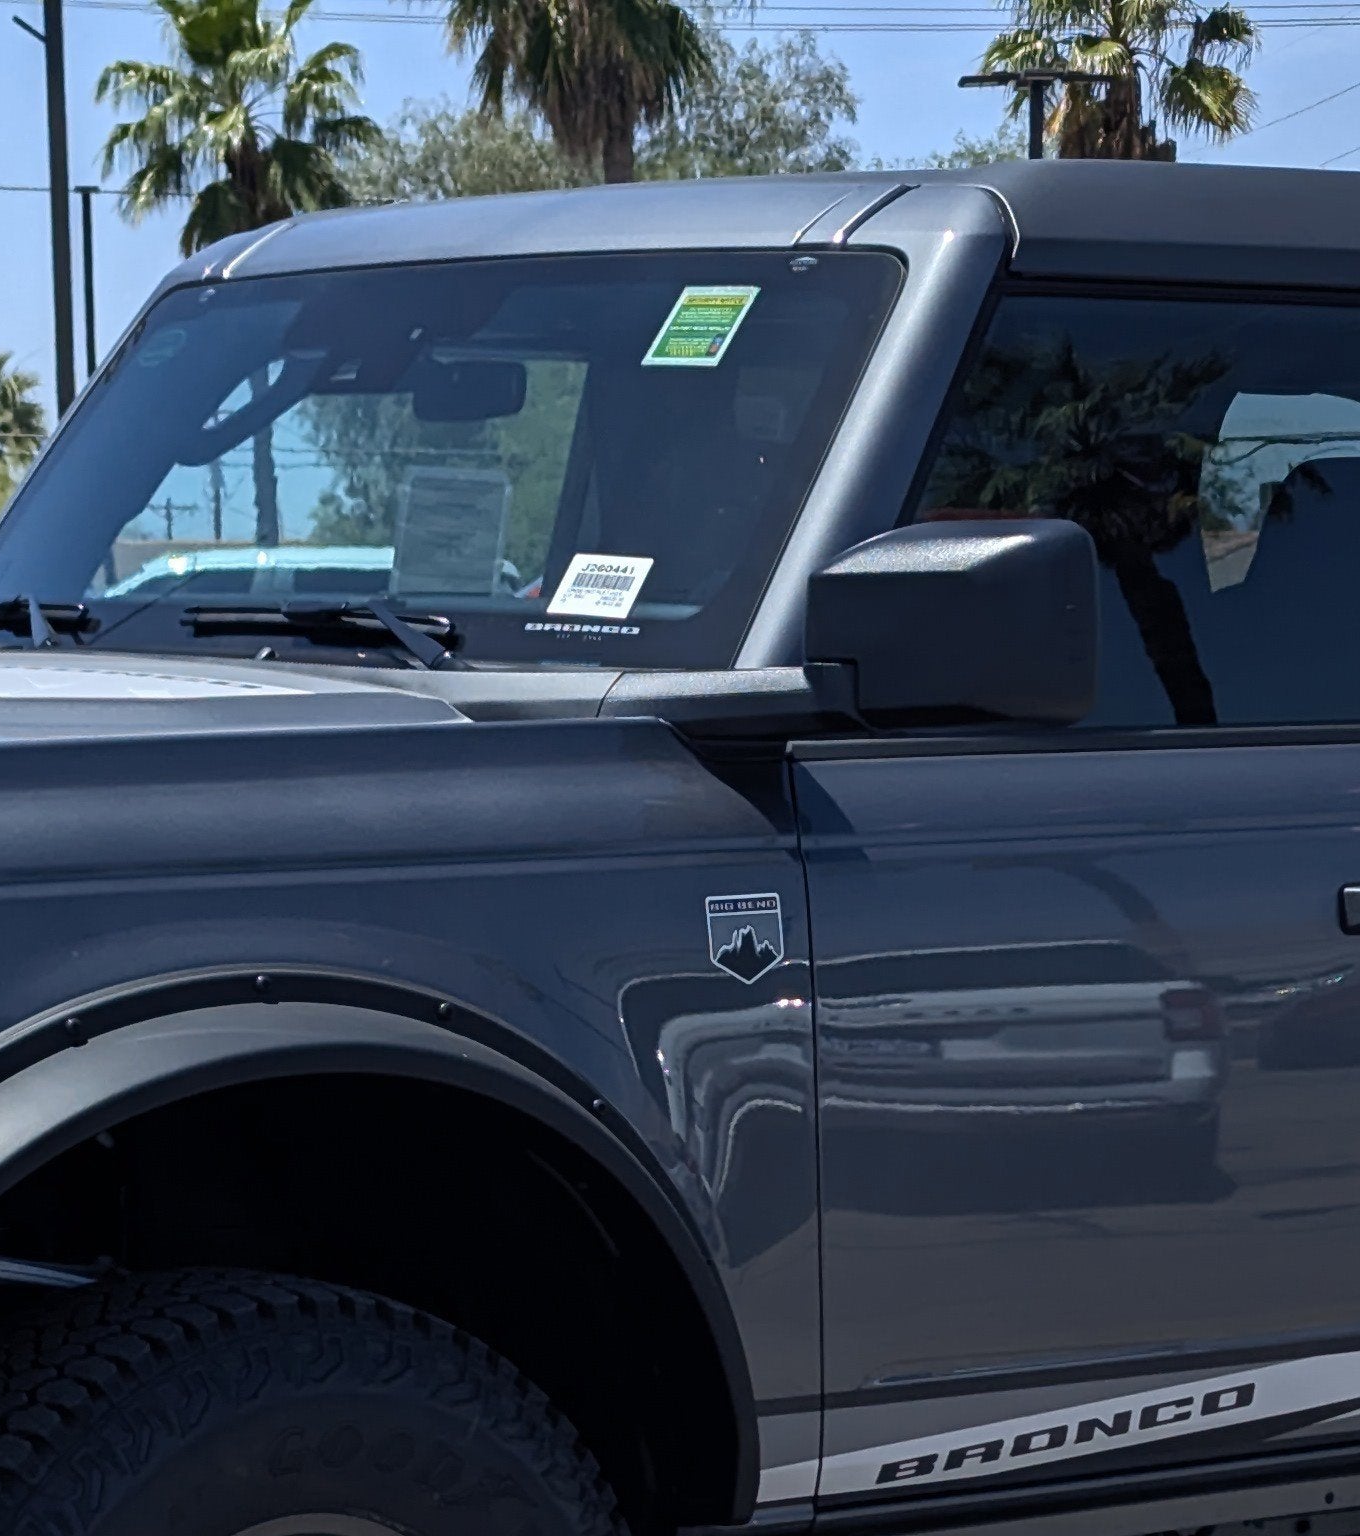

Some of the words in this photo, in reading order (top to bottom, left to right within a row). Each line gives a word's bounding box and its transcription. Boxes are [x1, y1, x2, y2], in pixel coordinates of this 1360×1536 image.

[524, 622, 641, 635] BRONCO
[710, 902, 735, 911] BIG
[737, 899, 777, 910] BEND
[874, 1381, 1256, 1486] BRONCO
